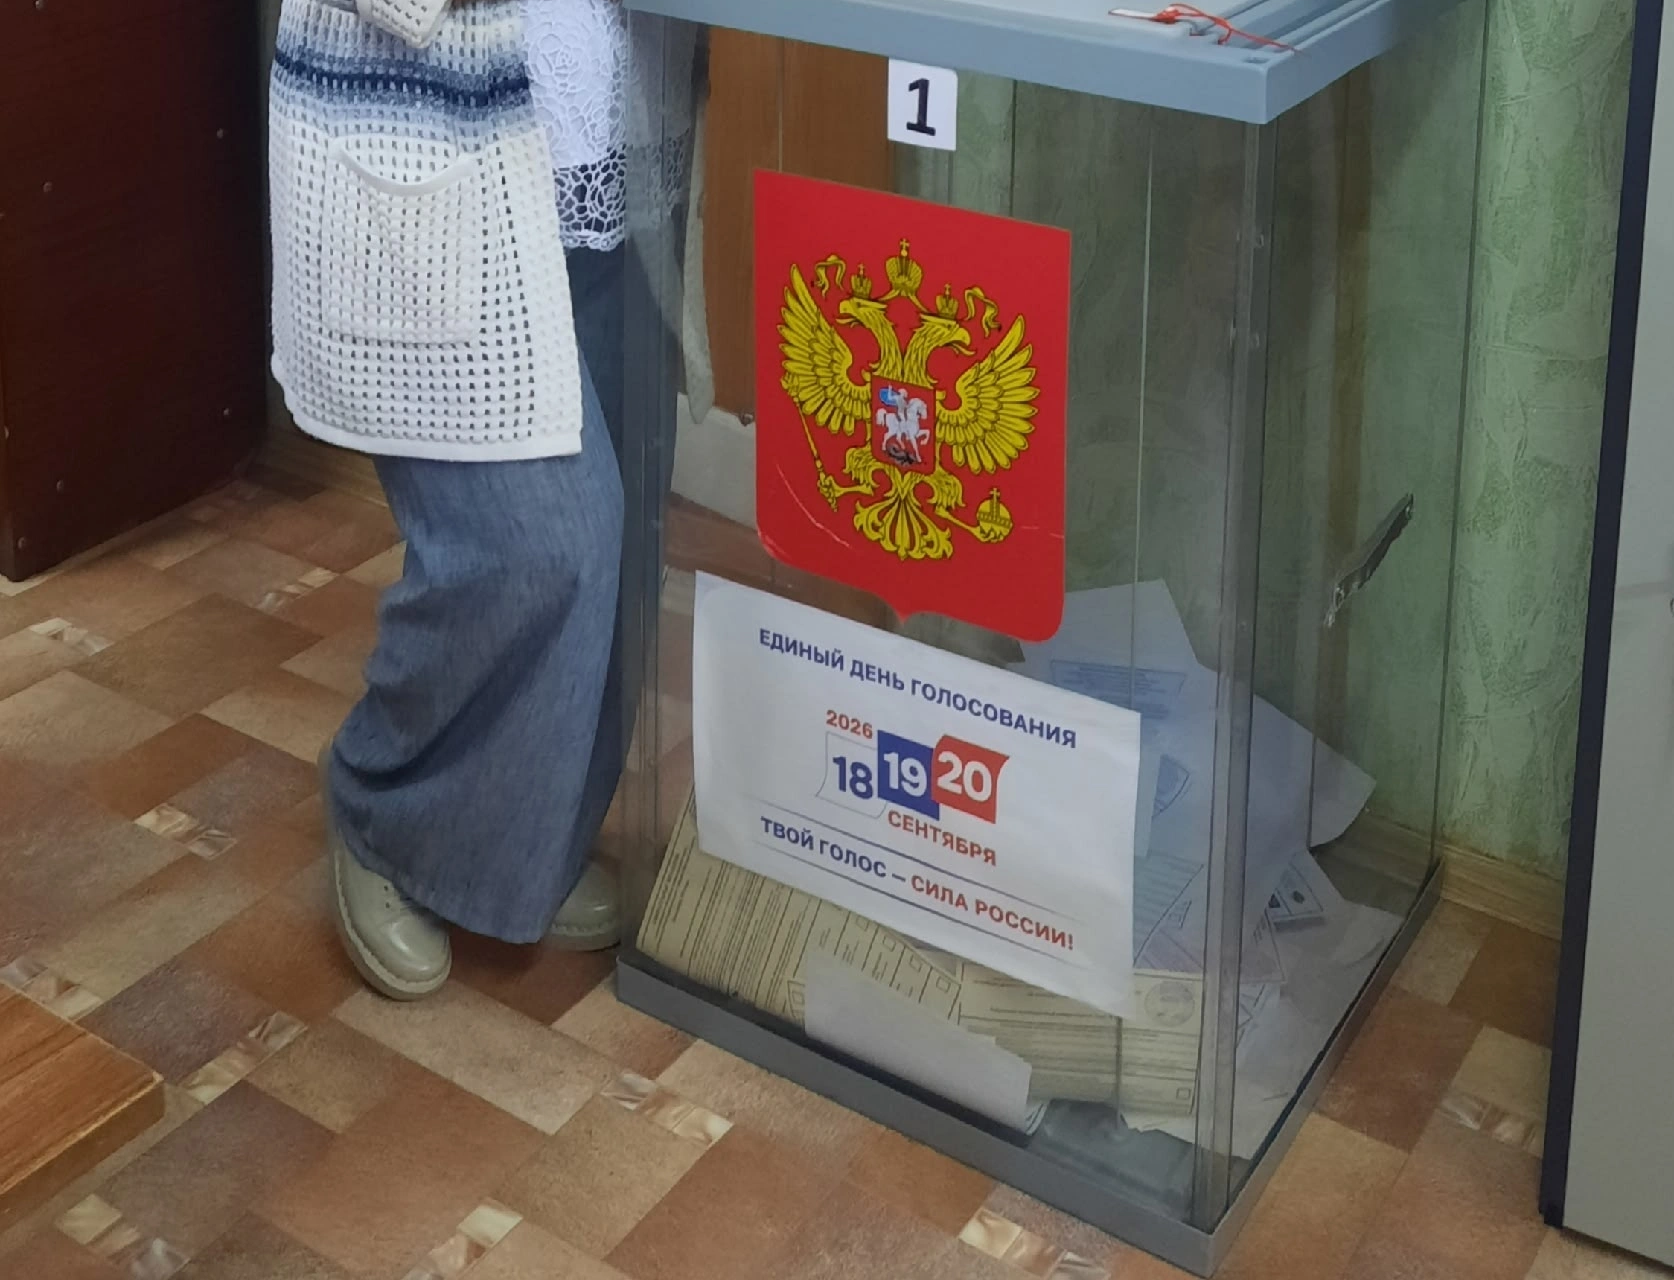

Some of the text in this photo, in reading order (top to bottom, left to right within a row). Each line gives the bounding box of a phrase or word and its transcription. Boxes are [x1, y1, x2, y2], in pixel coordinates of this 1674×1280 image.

[906, 78, 936, 136] 1
[759, 627, 845, 672] ЕДИНЫЙ
[849, 658, 905, 692] ДЕНЬ
[910, 677, 1077, 749] ГОЛОСОВАНИЯ
[825, 708, 874, 740] 2026
[832, 750, 993, 803] 18 19 20
[887, 810, 997, 867] СЕНТЯБРЯ
[760, 815, 815, 852] ТВОЙ
[819, 840, 887, 880] ГОЛОС
[910, 873, 969, 912] СИЛА
[975, 898, 1075, 951] РОССИИ!
